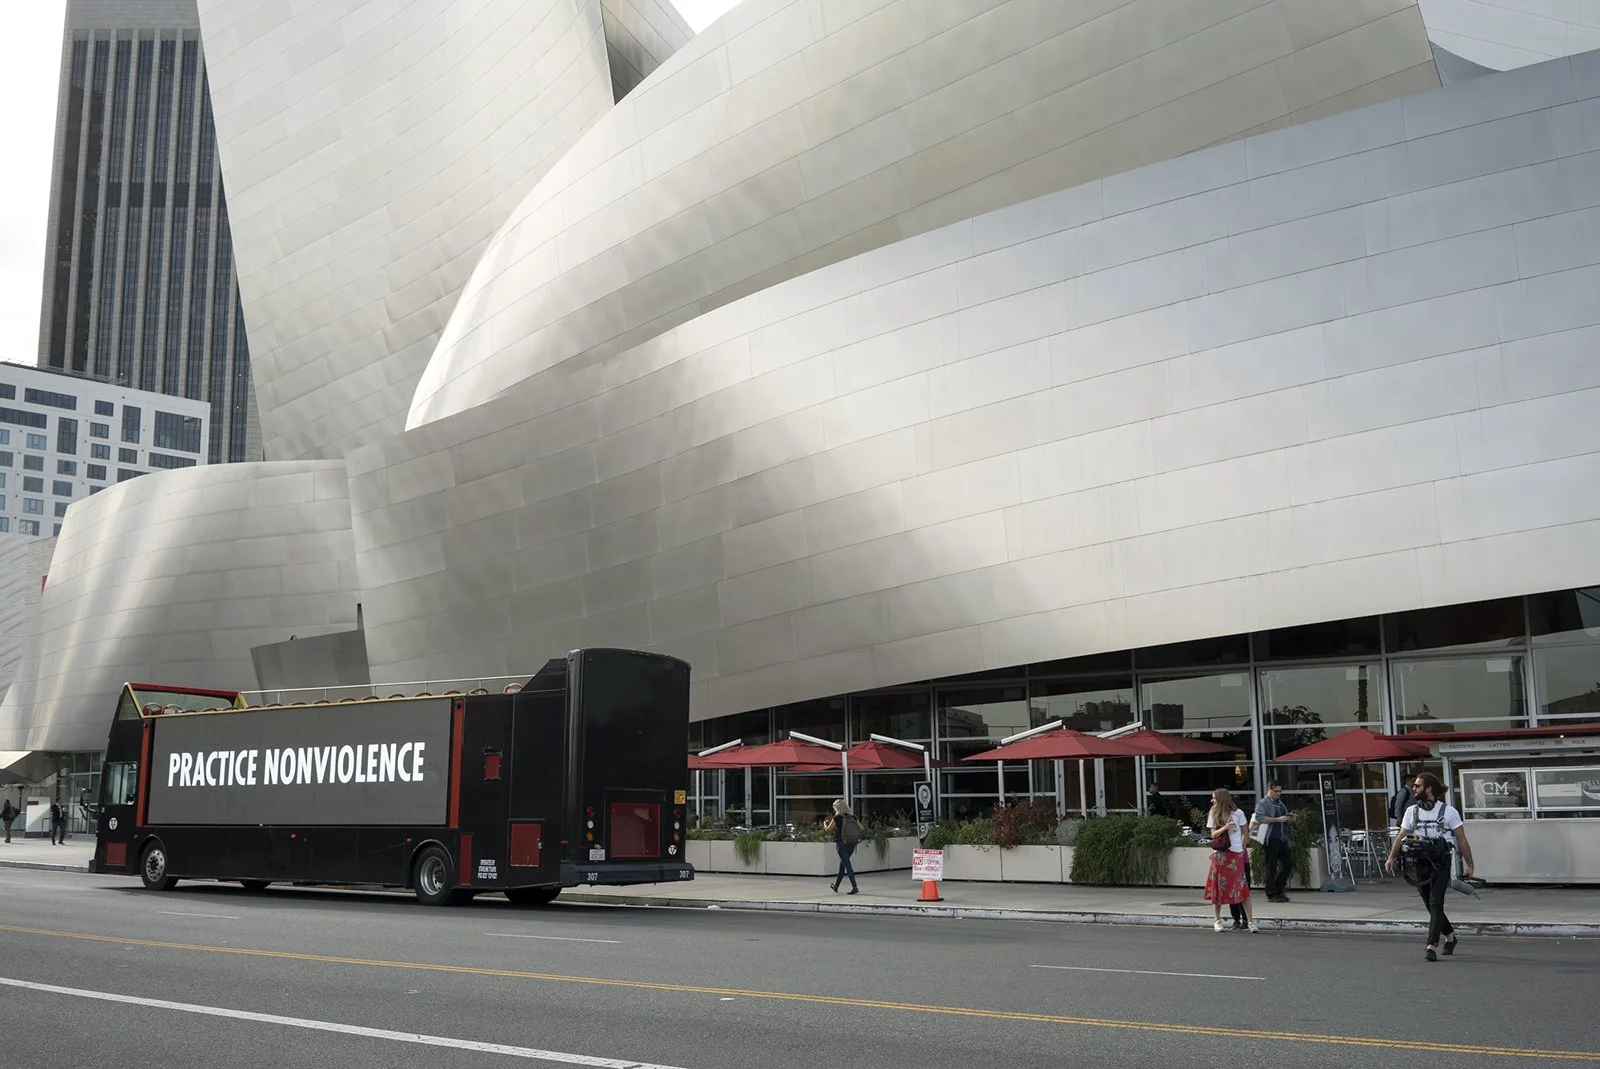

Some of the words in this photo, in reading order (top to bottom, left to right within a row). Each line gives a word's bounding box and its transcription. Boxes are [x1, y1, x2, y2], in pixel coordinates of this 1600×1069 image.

[168, 750, 258, 787] PRACTICE
[263, 742, 425, 785] NONVIOLENCE
[914, 857, 923, 865] NO
[587, 872, 598, 880] 307
[680, 870, 689, 878] 307
